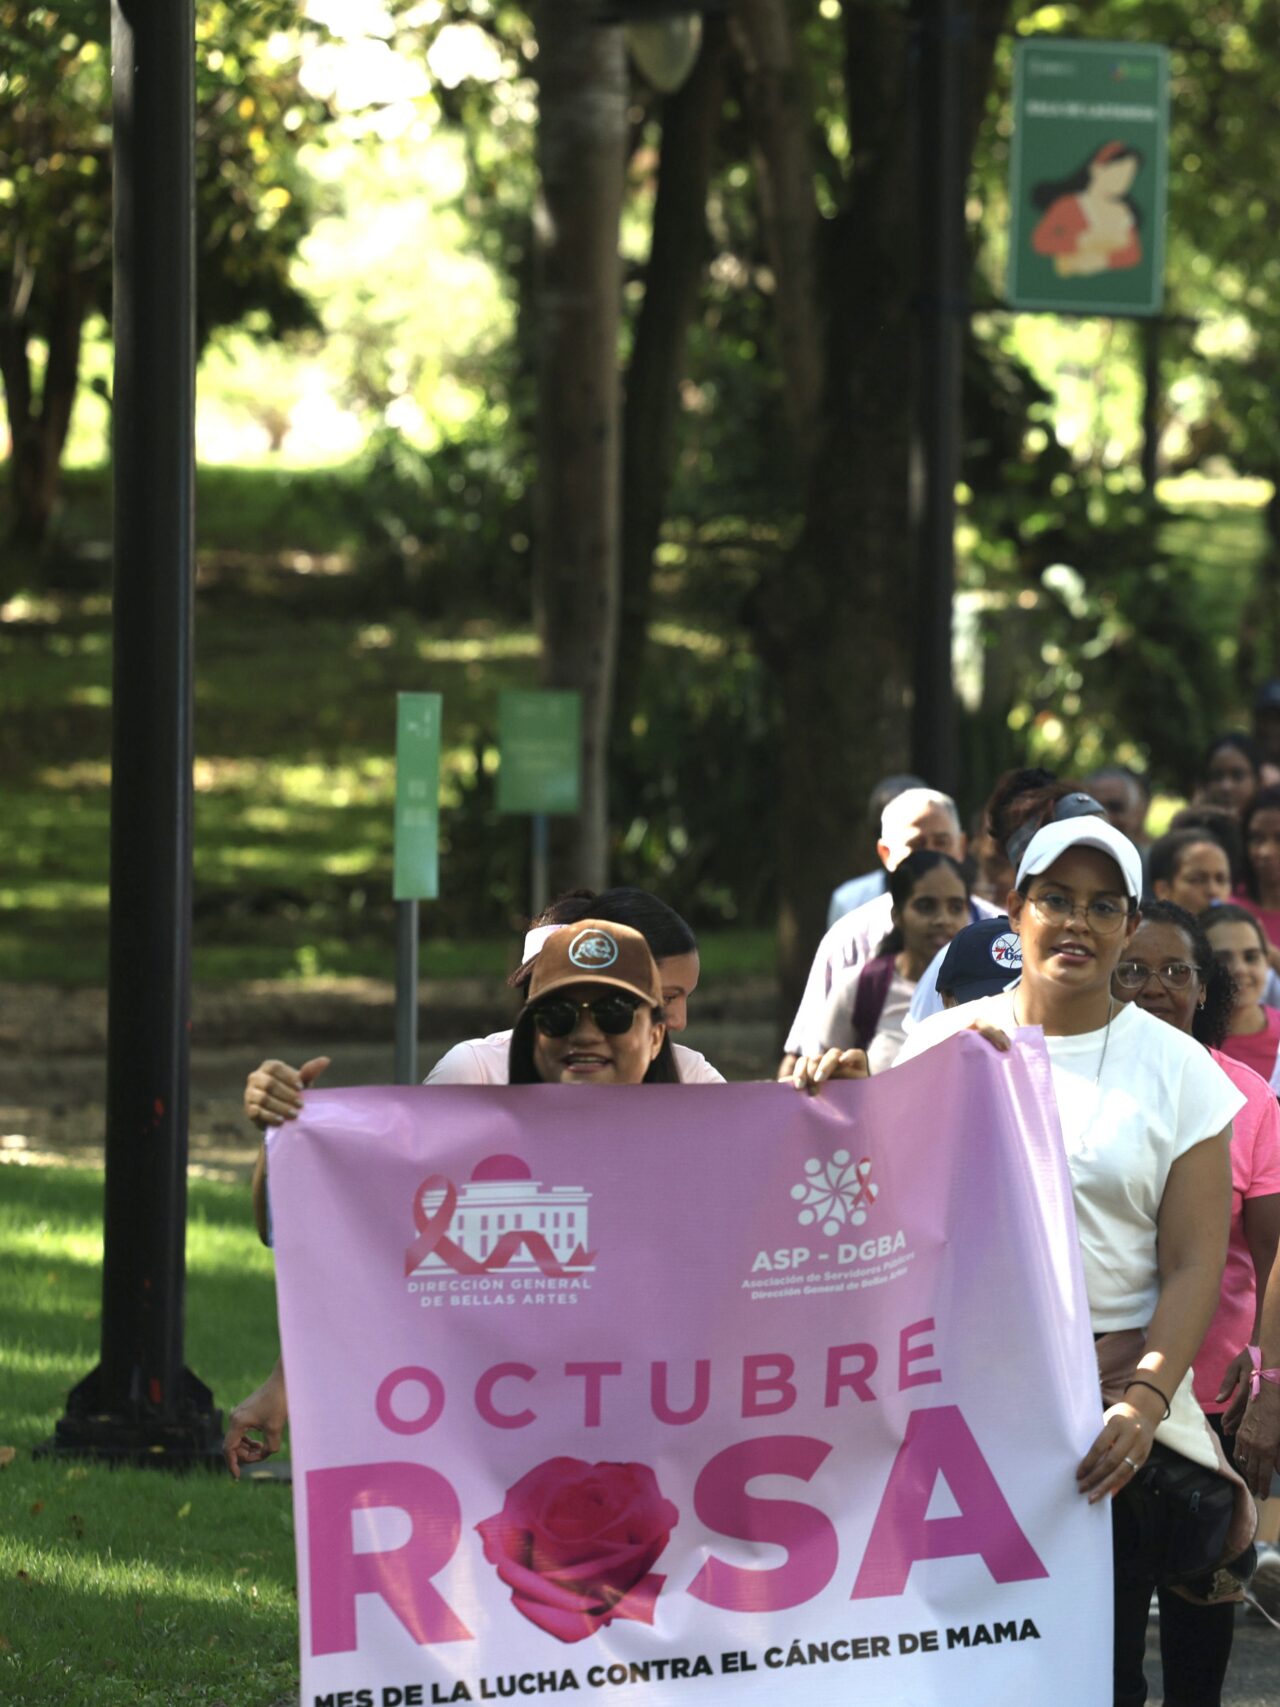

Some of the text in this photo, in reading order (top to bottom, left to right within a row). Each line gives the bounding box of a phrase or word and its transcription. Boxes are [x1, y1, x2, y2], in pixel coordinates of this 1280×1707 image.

[751, 1247, 811, 1273] ASP
[837, 1229, 907, 1264] DGBA
[420, 1293, 579, 1308] DE BELLAS ARTES
[510, 1278, 592, 1290] GENERAL
[375, 1318, 943, 1436] OCTUBRE
[382, 1684, 424, 1707] DE
[431, 1680, 472, 1705] LA
[480, 1669, 580, 1699] LUCHA
[587, 1655, 714, 1688] CONTRA
[721, 1650, 758, 1675] EL
[764, 1635, 891, 1669] CÁNCER
[898, 1630, 940, 1656] DE
[946, 1618, 1041, 1649] MAMA
